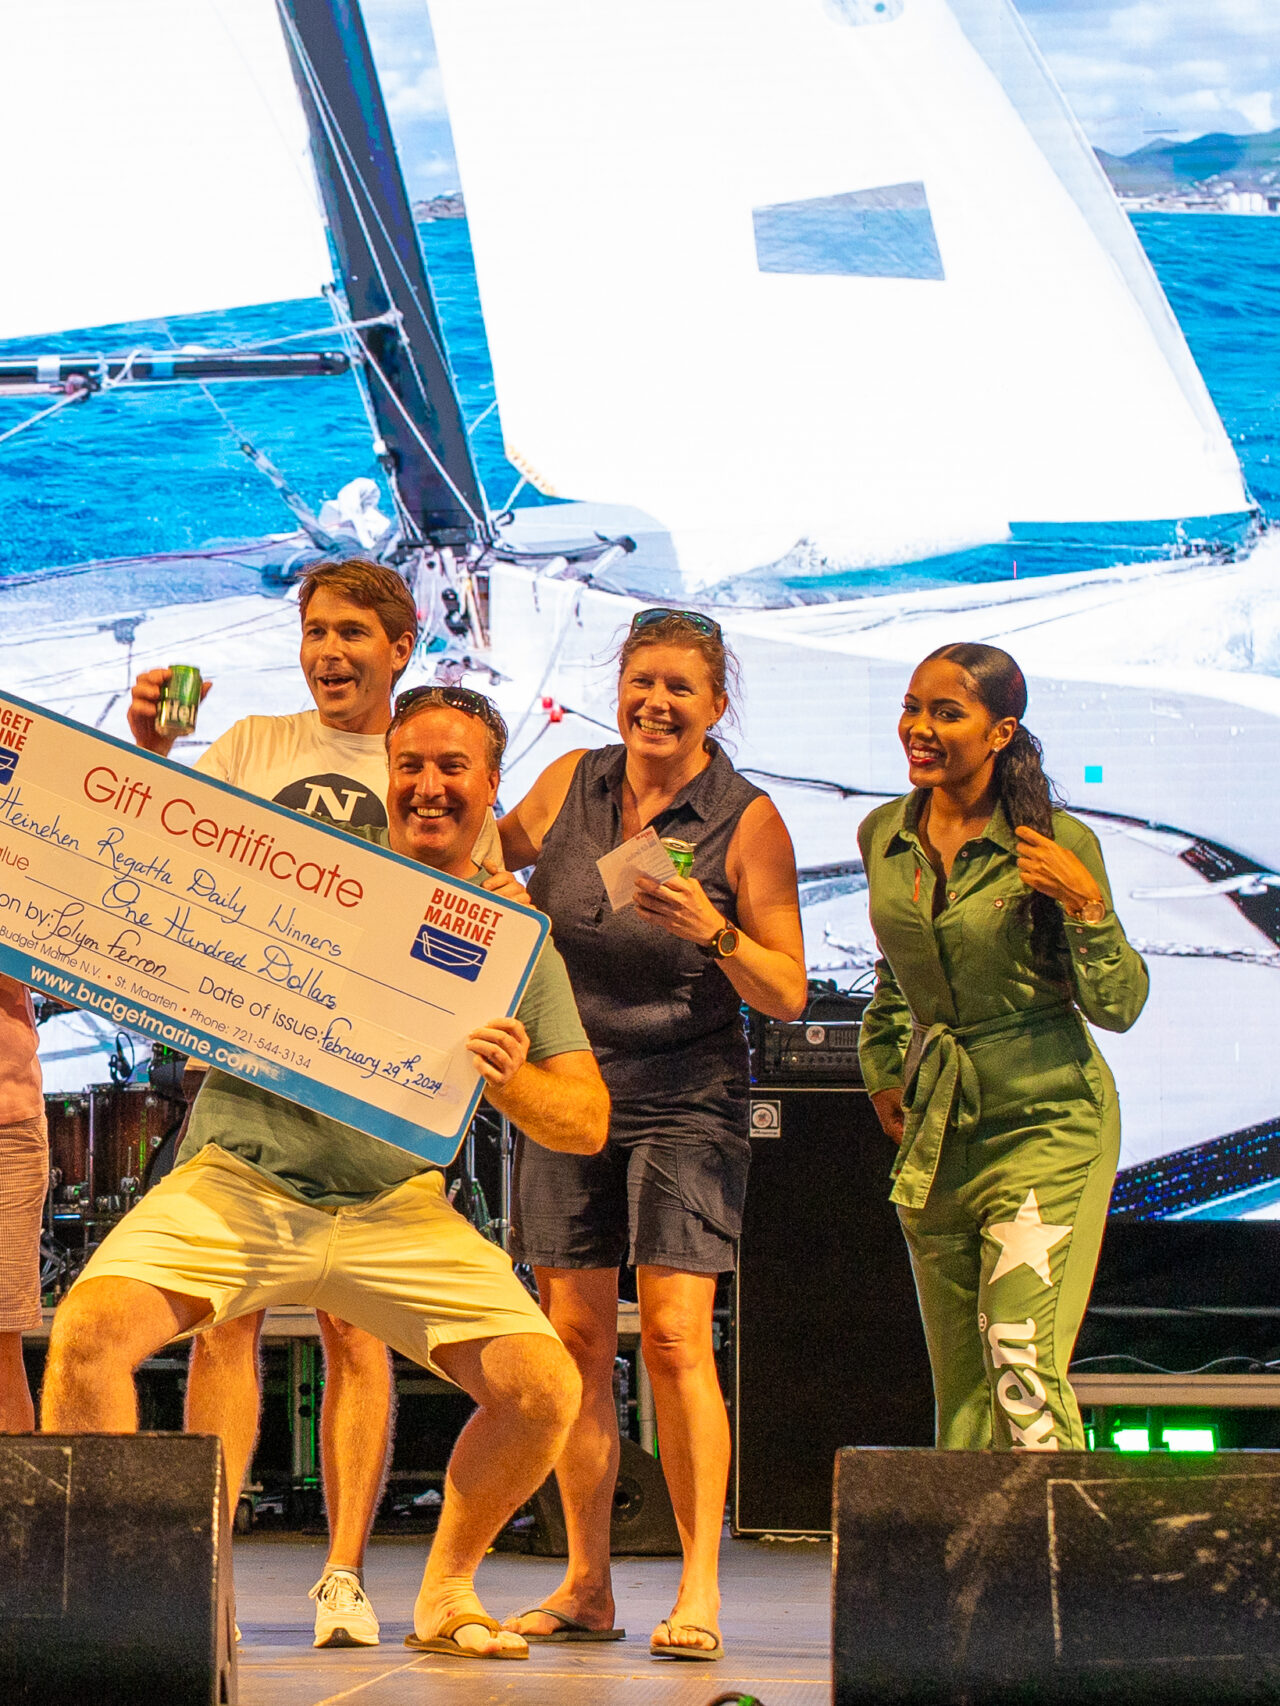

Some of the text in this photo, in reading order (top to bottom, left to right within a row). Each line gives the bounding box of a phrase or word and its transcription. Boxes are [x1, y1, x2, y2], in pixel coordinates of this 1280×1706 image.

[298, 782, 367, 822] N
[83, 766, 364, 908] Gift Certificate
[24, 901, 55, 929] by:
[97, 827, 174, 885] Regatta
[187, 868, 248, 924] Daily
[268, 903, 343, 957] Winners
[430, 887, 504, 929] BUDGET
[102, 879, 338, 1011] One Hundred Dollars
[423, 905, 497, 948] MARINE
[29, 964, 261, 1078] www.budgetmarine.com
[39, 942, 79, 968] Marine
[80, 959, 102, 980] N.V.
[114, 975, 131, 991] St.
[130, 982, 179, 1012] Maarten
[190, 1008, 231, 1035] Phone:
[232, 1025, 313, 1070] 721-544-3134
[198, 976, 324, 1044] Date of issue:
[413, 1073, 443, 1095] 2024
